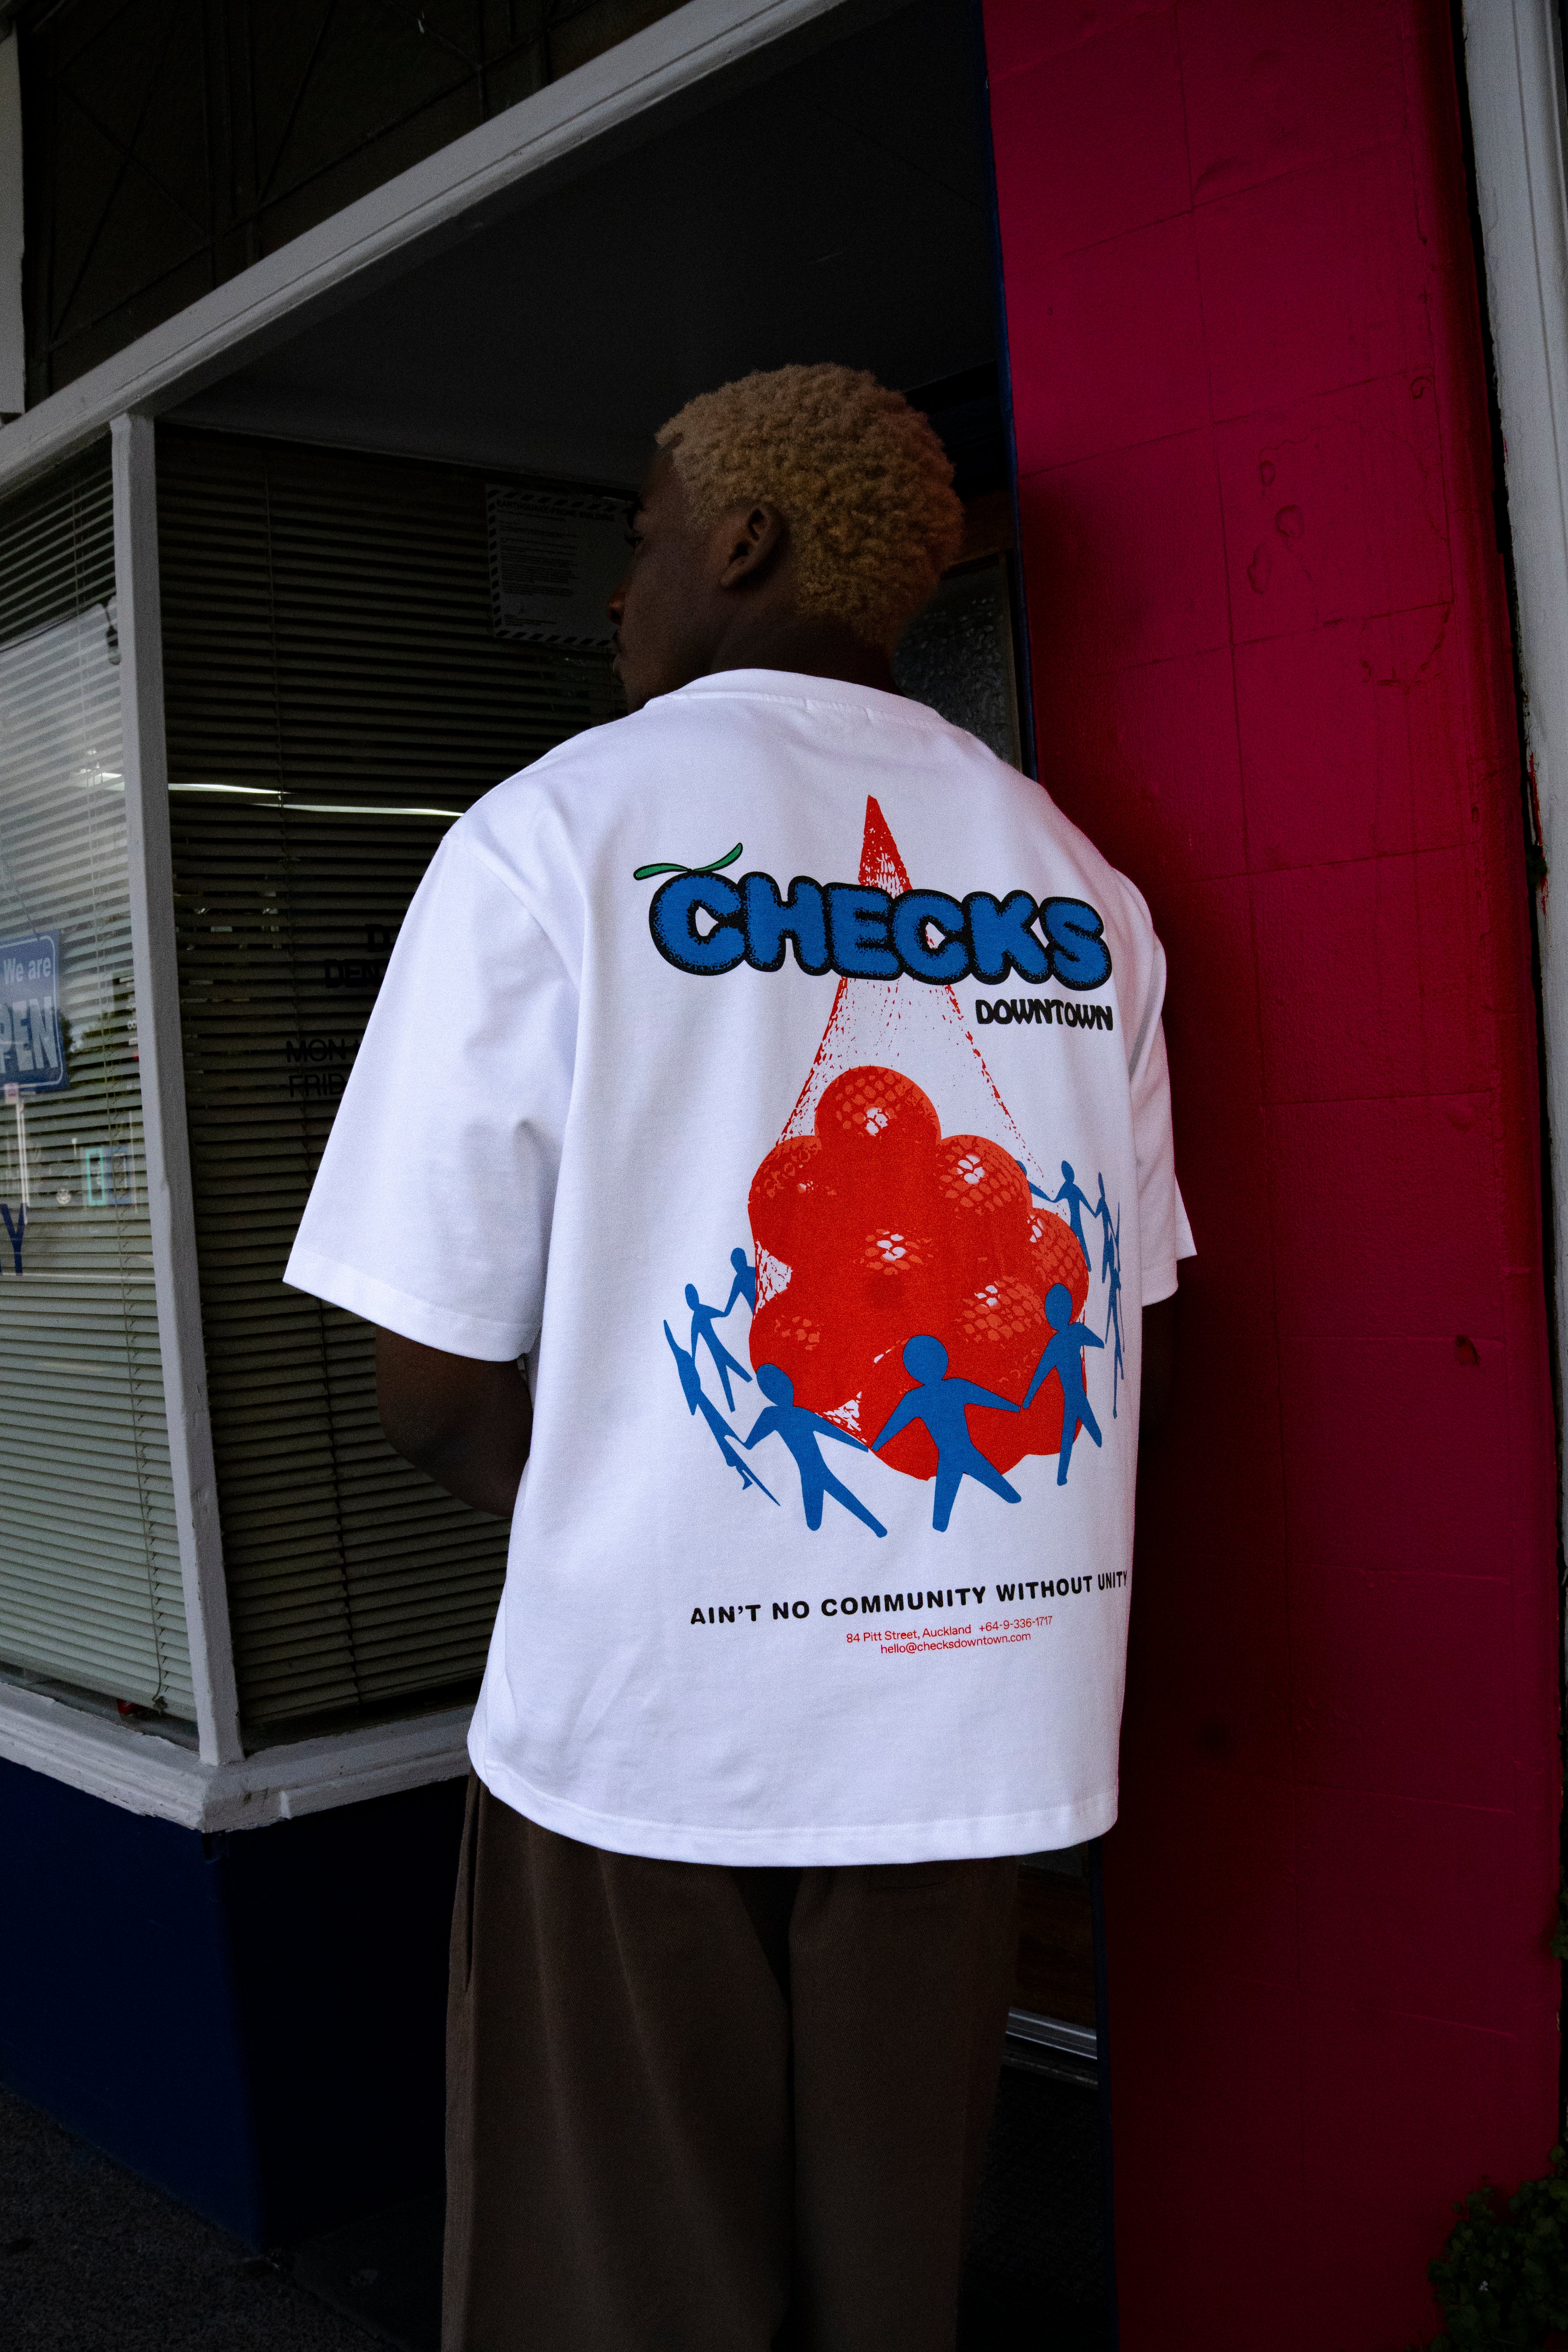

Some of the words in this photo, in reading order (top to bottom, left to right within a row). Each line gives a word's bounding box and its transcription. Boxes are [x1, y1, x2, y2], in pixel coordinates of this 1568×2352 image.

[649, 870, 1112, 991] CHECKS
[3, 958, 24, 985] We
[28, 957, 51, 980] are
[324, 958, 388, 988] DEN
[975, 999, 1113, 1031] DOWNTOWN
[286, 1038, 346, 1063] MON
[0, 1203, 25, 1276] Y
[772, 1601, 809, 1620] NO
[822, 1587, 986, 1617] COMMUNITY
[996, 1576, 1093, 1602] WITHOUT
[1097, 1570, 1127, 1590] UNITY
[846, 1633, 860, 1643] 84
[863, 1632, 882, 1642] Pitt
[885, 1630, 920, 1641] Street,
[922, 1624, 972, 1638] Auckland
[979, 1615, 1053, 1632] +64-9-336-1717
[880, 1633, 1031, 1654] hello@checksdowntown.com
